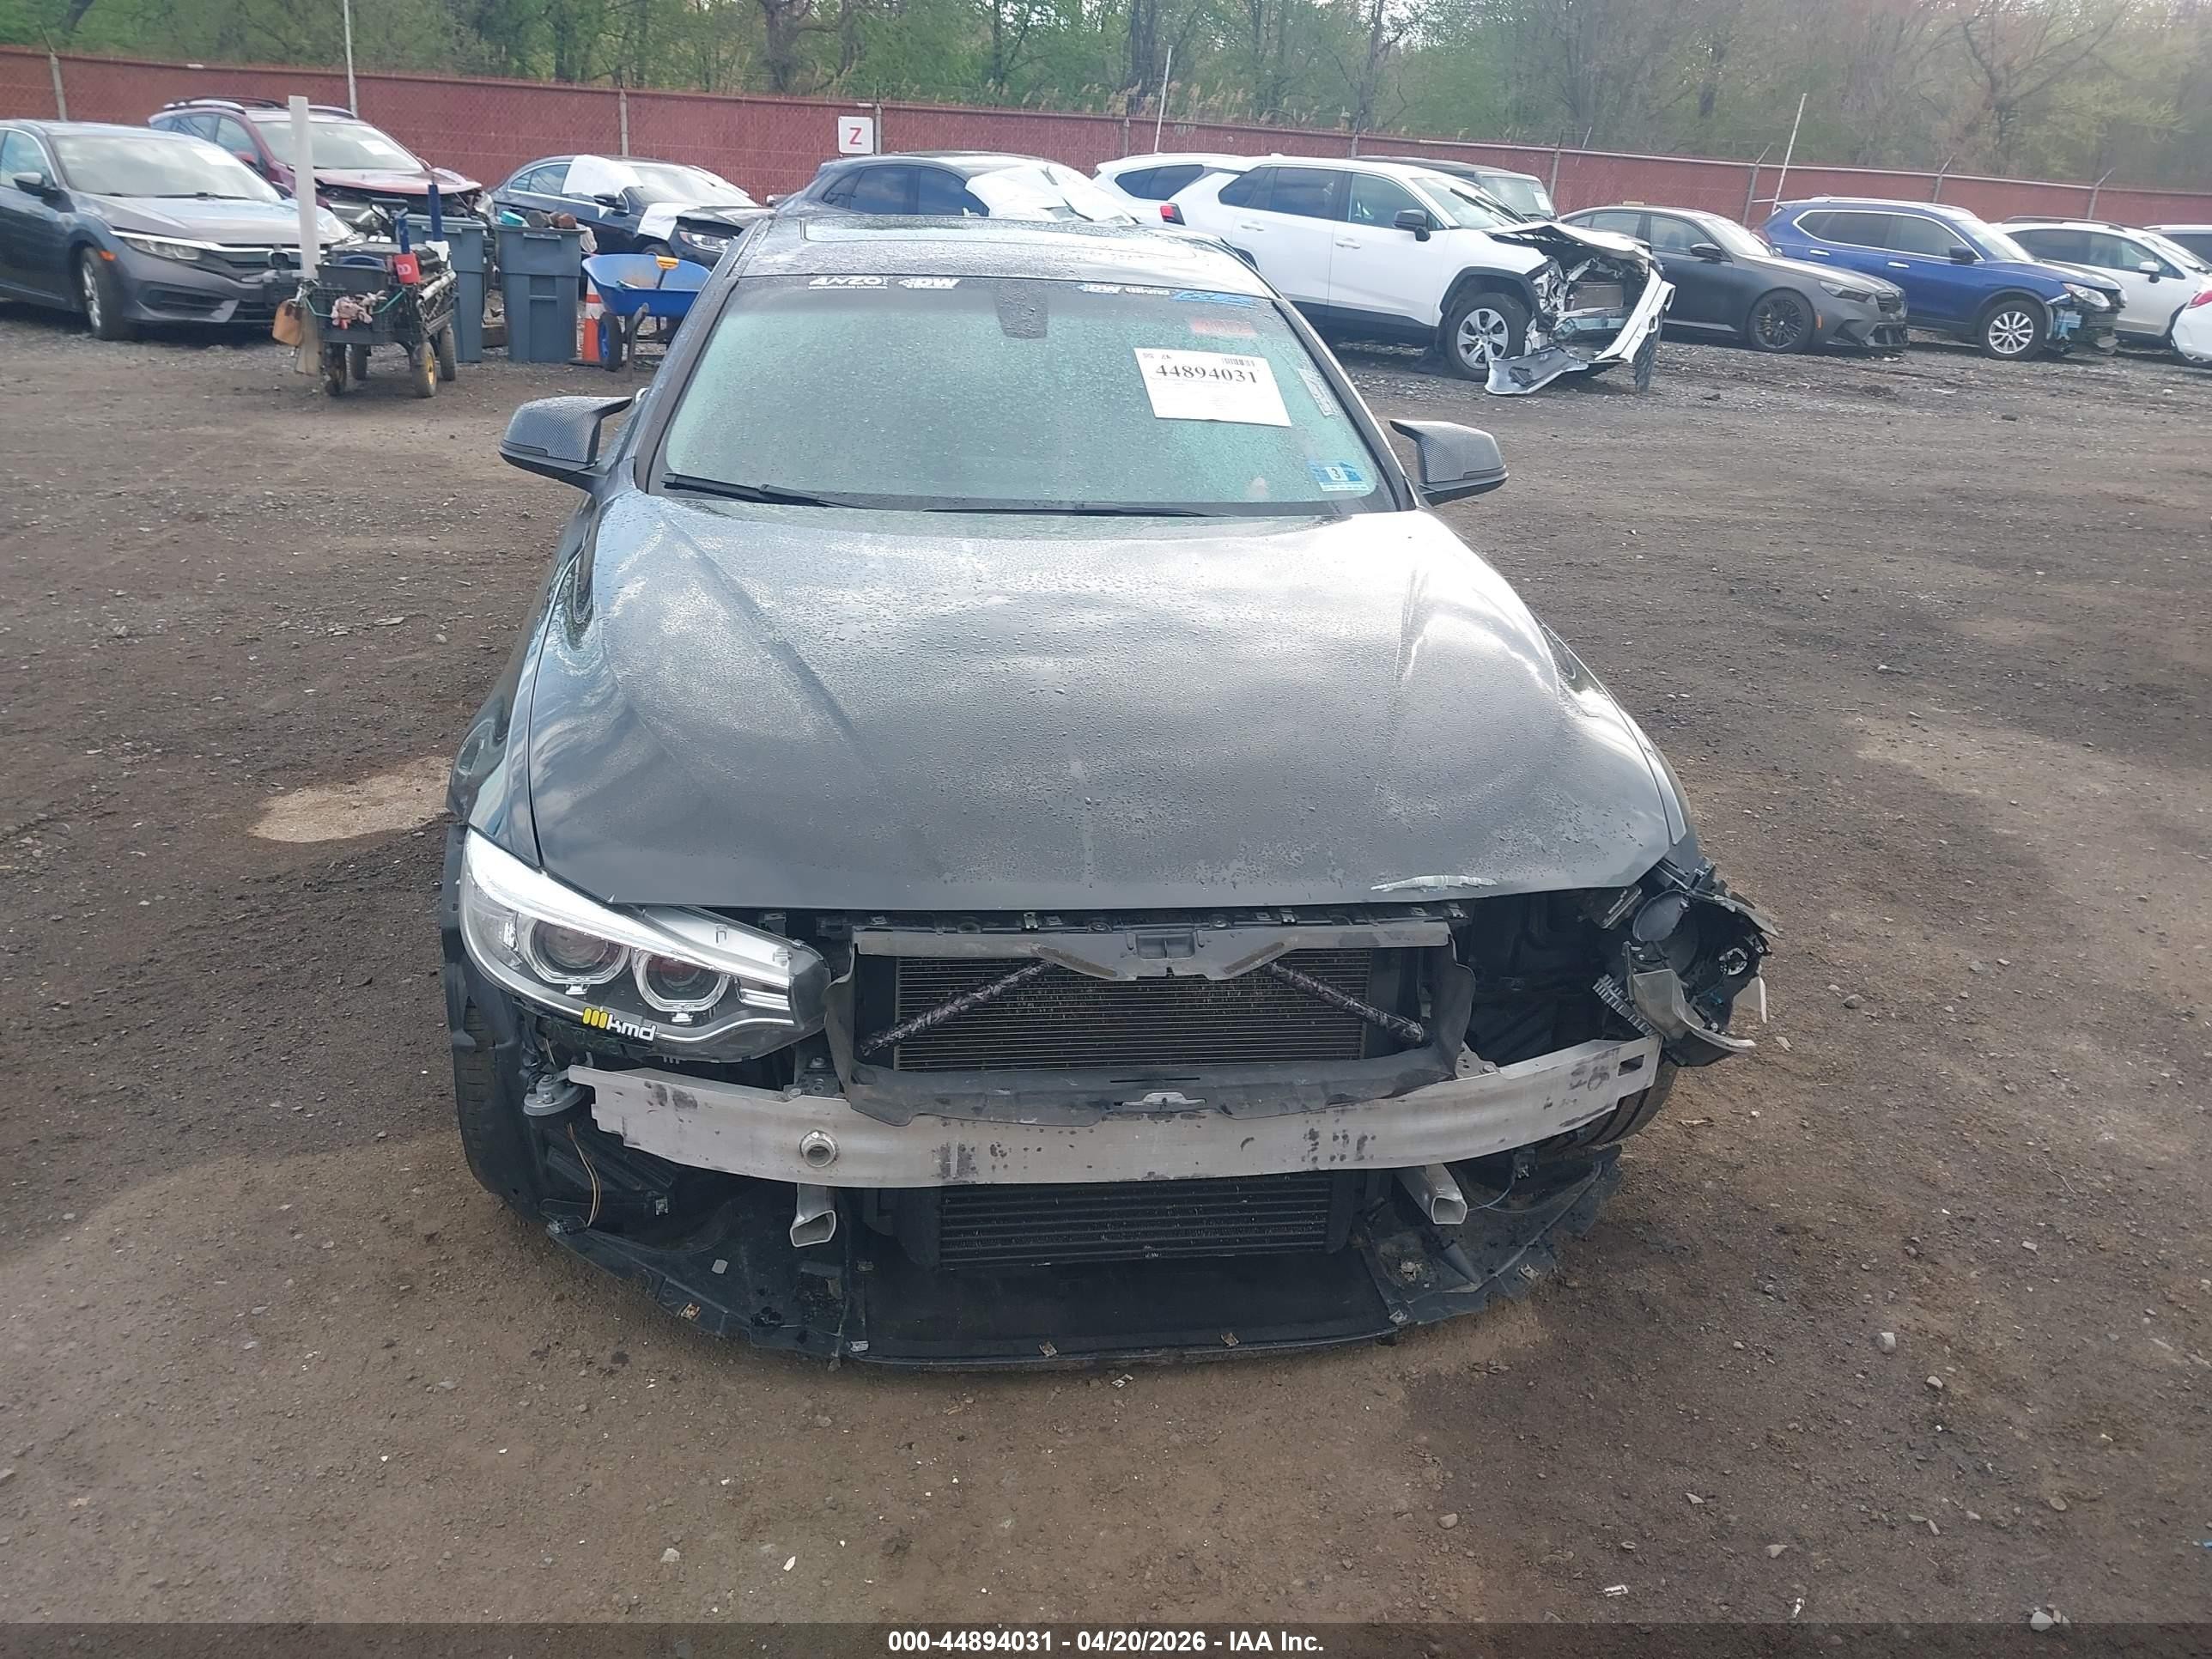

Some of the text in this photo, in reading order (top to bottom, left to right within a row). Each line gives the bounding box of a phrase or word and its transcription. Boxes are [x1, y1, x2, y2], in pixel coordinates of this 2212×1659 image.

[849, 127, 862, 145] Z
[809, 276, 882, 285] ANZO
[1156, 364, 1257, 384] 44894031
[1332, 468, 1340, 479] 3
[606, 1013, 656, 1042] kmd
